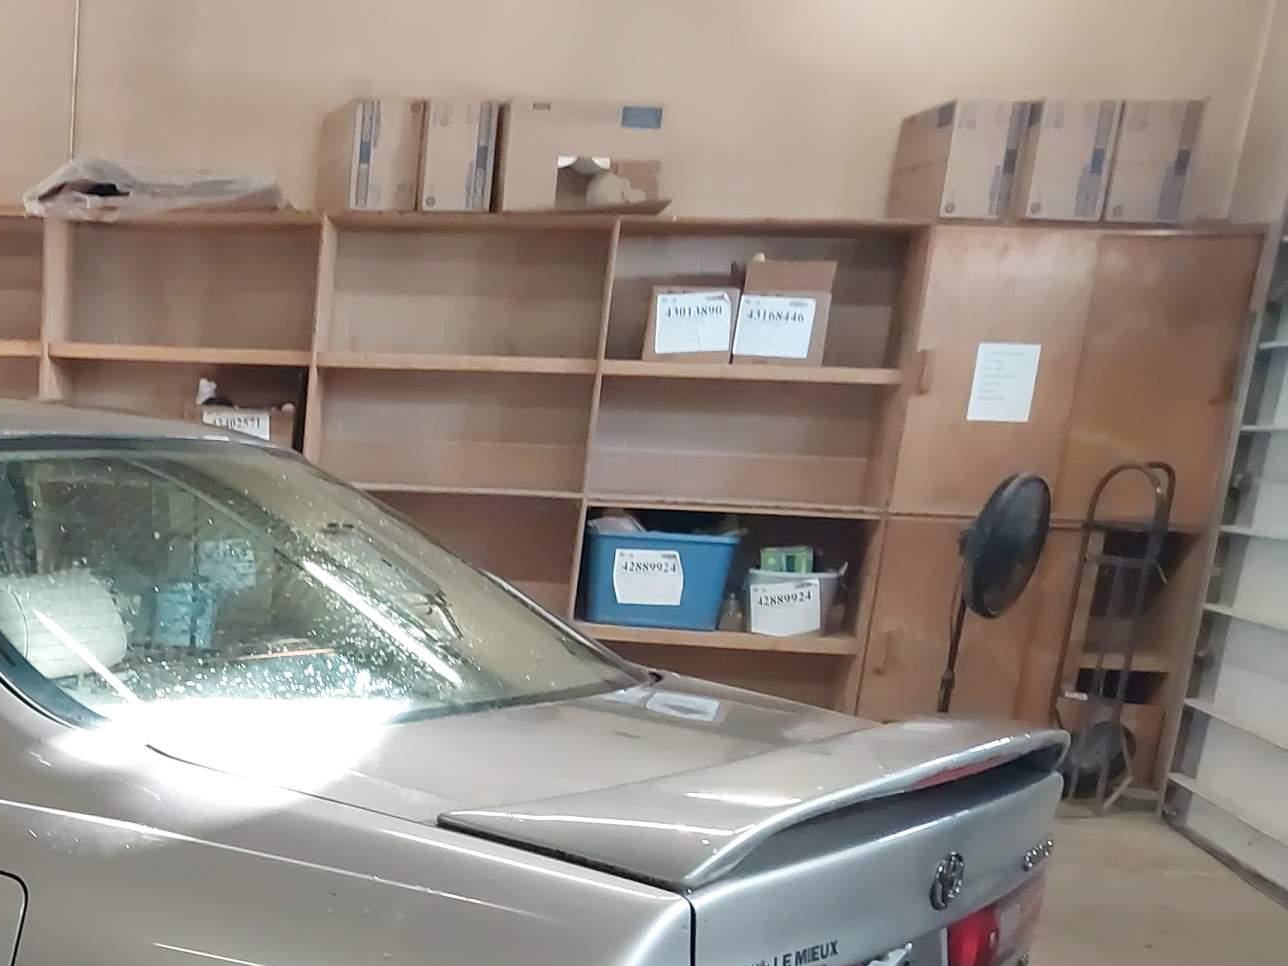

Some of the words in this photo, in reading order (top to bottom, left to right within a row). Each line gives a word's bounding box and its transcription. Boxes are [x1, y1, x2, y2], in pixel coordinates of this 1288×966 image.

[664, 303, 723, 318] 43013890
[746, 308, 805, 323] 43168446
[620, 559, 677, 573] 42889924
[756, 589, 812, 607] 42889924
